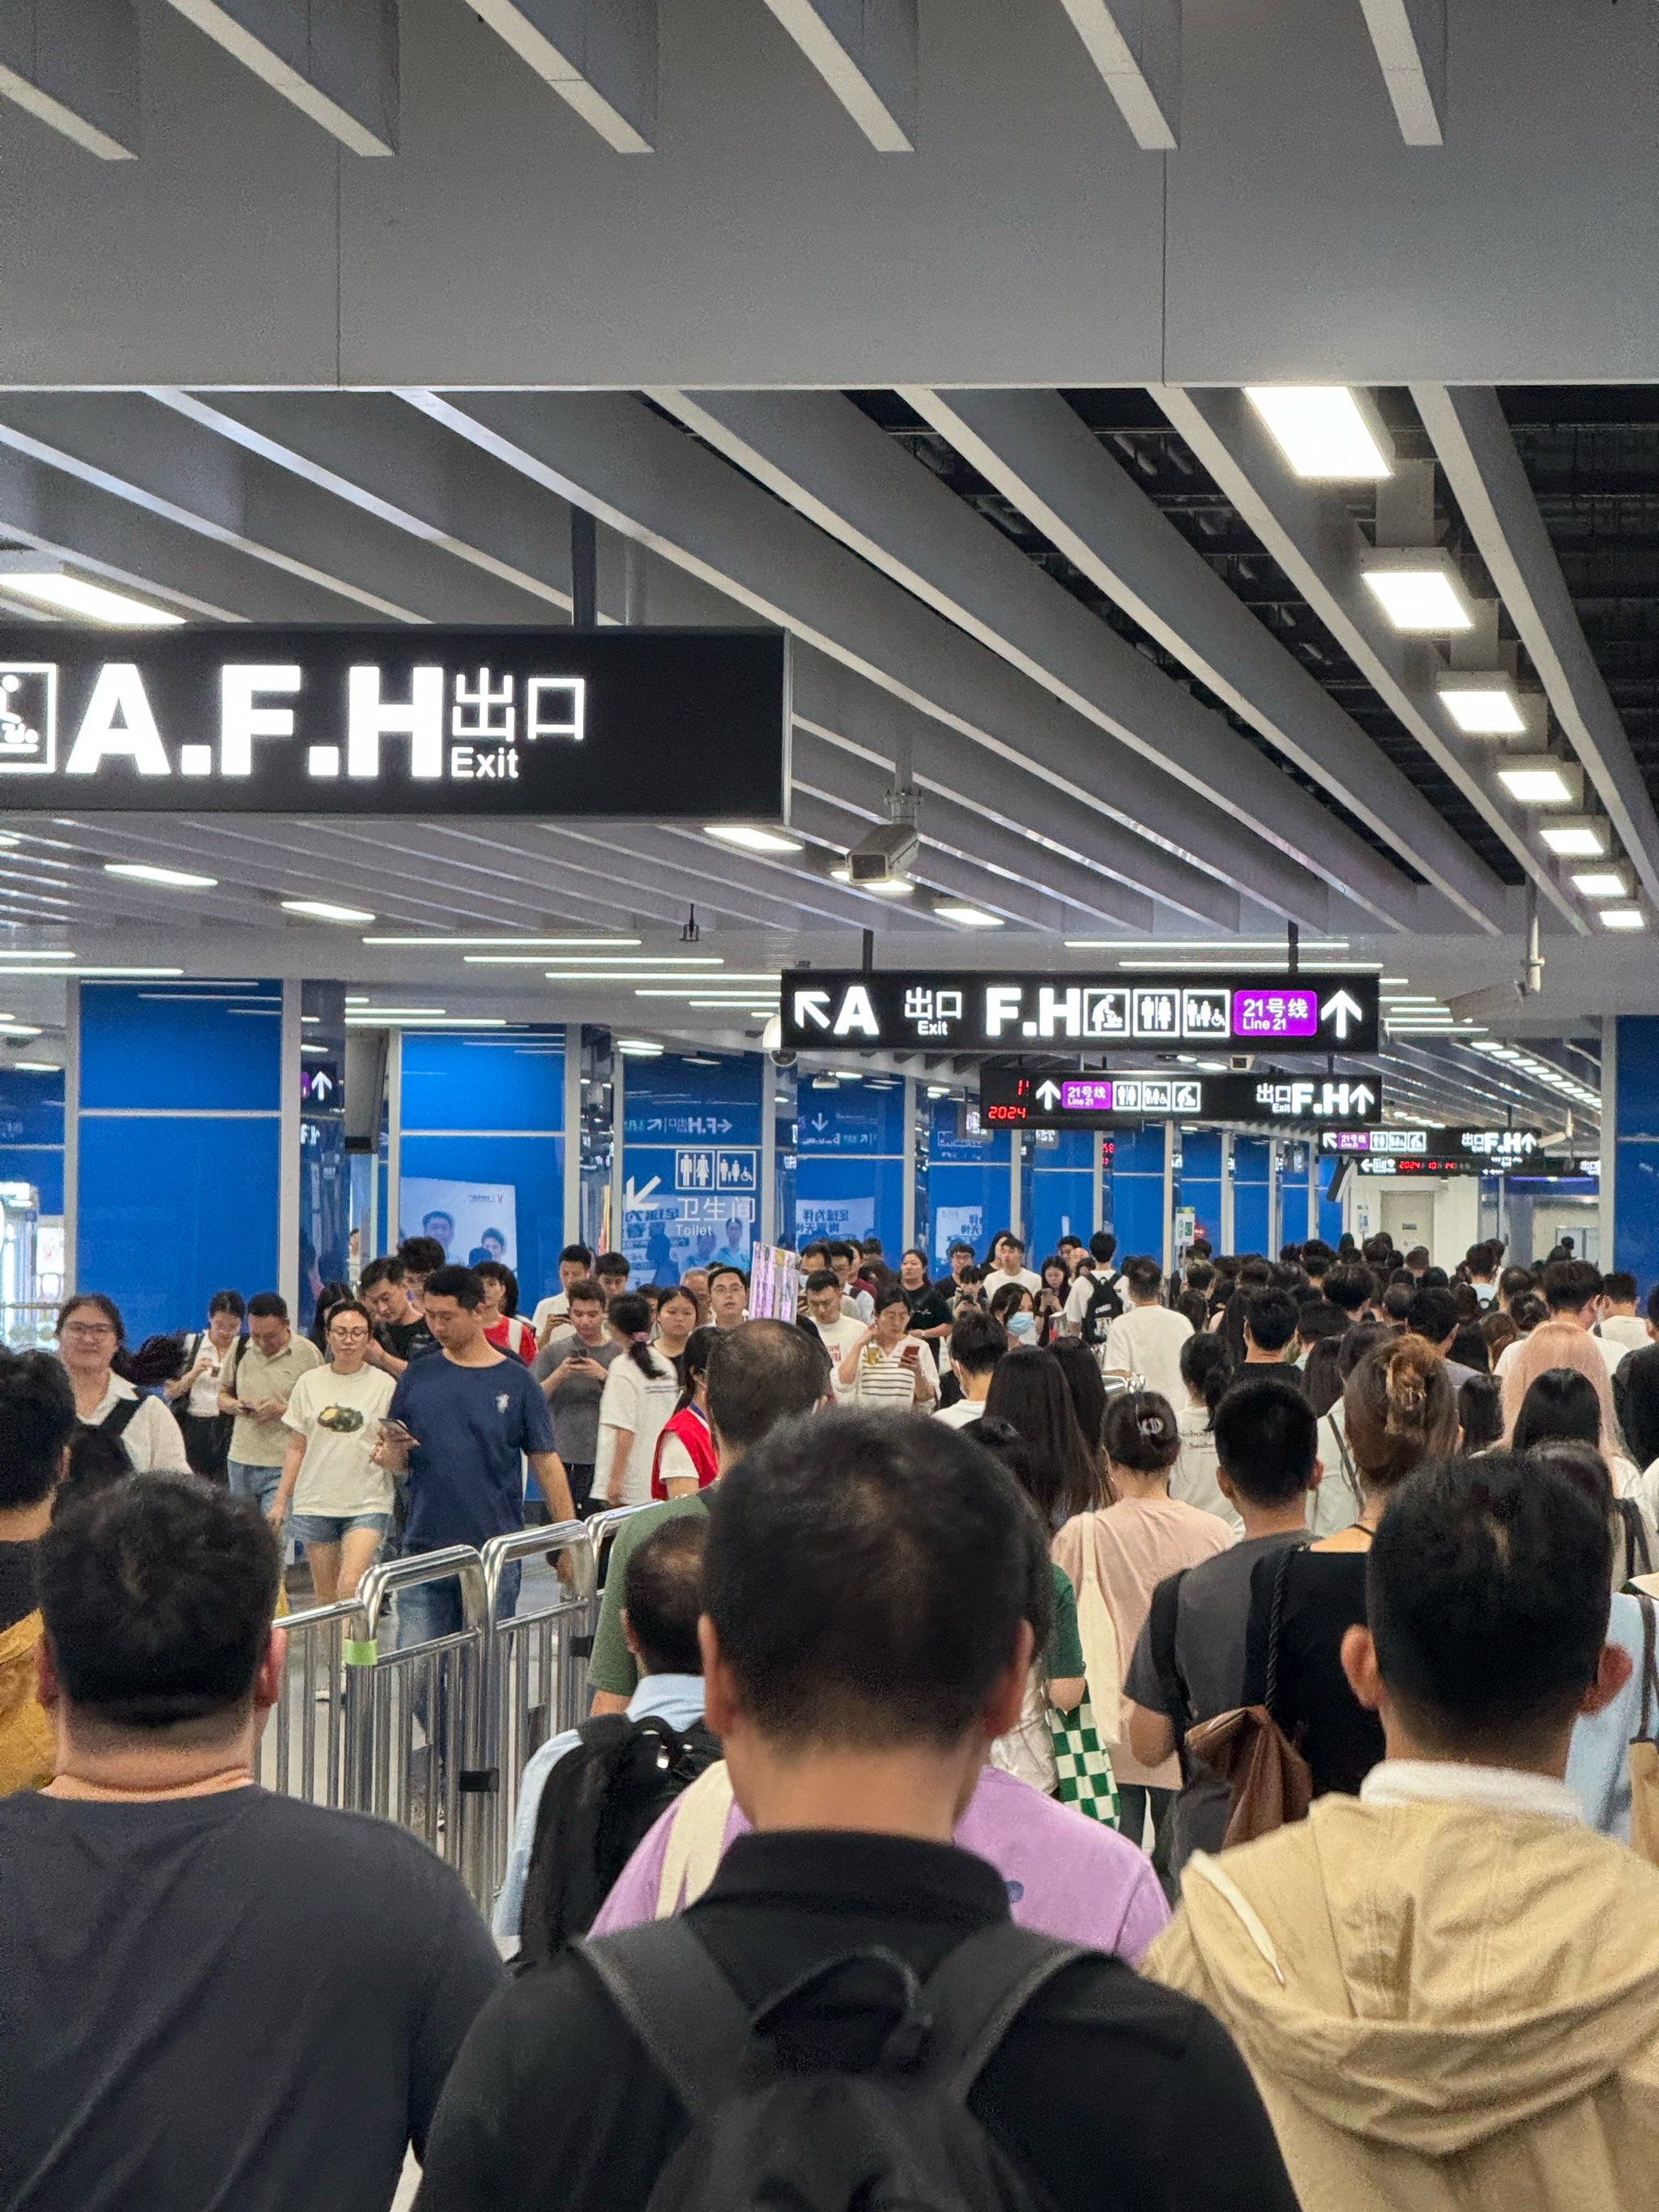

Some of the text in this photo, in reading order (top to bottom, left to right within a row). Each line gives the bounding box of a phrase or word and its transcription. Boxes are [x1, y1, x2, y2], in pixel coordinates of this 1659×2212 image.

[452, 668, 586, 743] 出口
[66, 663, 443, 779] A.F.H
[450, 746, 519, 779] Exit
[833, 985, 880, 1036] A
[904, 987, 962, 1020] 出口
[986, 987, 1081, 1037] F.H
[1243, 997, 1308, 1018] 21号线
[917, 1020, 949, 1036] Exit
[1243, 1018, 1286, 1031] Line 21
[1068, 1086, 1106, 1100] 21号线
[1085, 1098, 1094, 1106] 21
[1256, 1083, 1291, 1103] 出口
[1291, 1083, 1350, 1115] F.H
[987, 1105, 1026, 1120] 2024
[1272, 1103, 1290, 1113] Exit
[1461, 1132, 1484, 1147] 出口
[1484, 1132, 1521, 1154] F.H
[1398, 1160, 1421, 1169] 2024
[675, 1196, 756, 1223] 卫生间
[676, 1224, 712, 1236] Toilet
